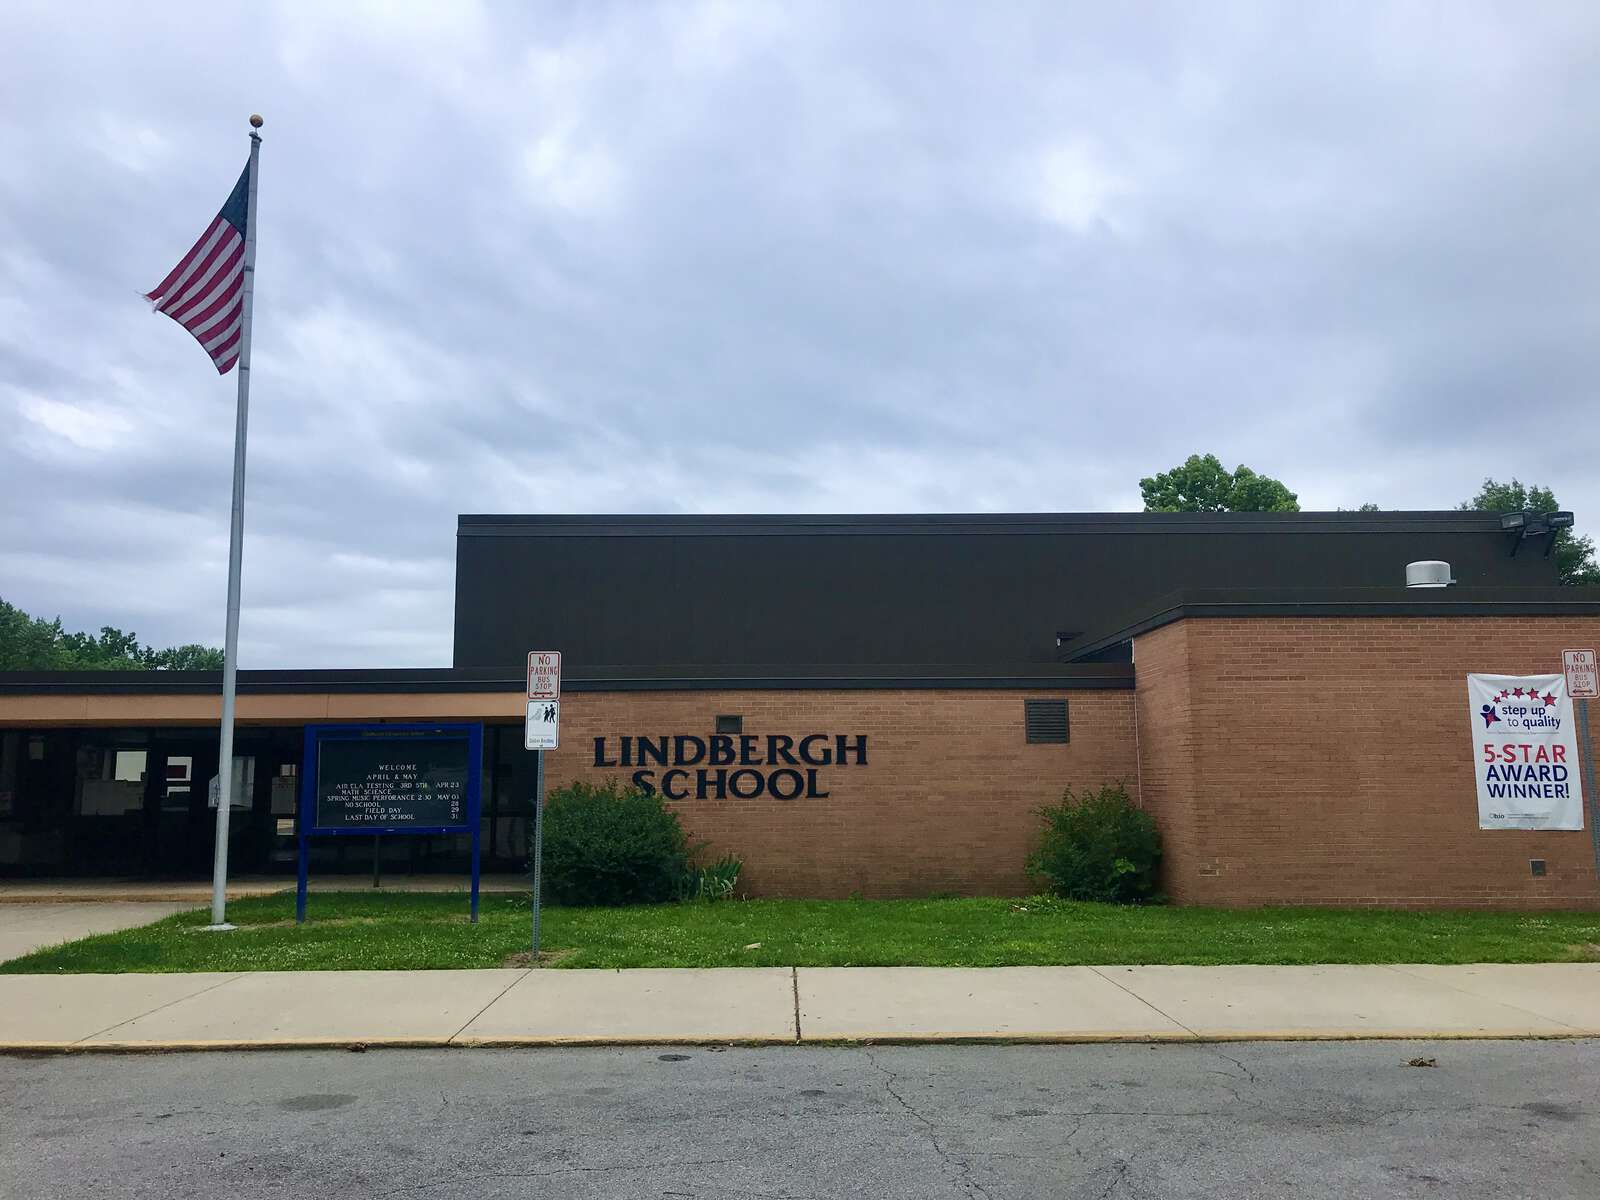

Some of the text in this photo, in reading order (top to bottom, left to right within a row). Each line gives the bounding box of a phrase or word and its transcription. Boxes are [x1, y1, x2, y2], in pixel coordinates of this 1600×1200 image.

[538, 656, 551, 665] NO
[1573, 654, 1586, 663] NO
[530, 667, 558, 675] PARKING
[1566, 664, 1595, 673] PARKING
[1573, 680, 1591, 688] STOP
[1502, 705, 1546, 718] step up
[1508, 715, 1561, 730] to quality
[593, 734, 868, 767] LINDBERGH
[1484, 744, 1567, 763] 5-STAR
[1486, 764, 1568, 782] AWARD
[632, 768, 829, 800] SCHOOL
[1487, 783, 1570, 799] WINNER!
